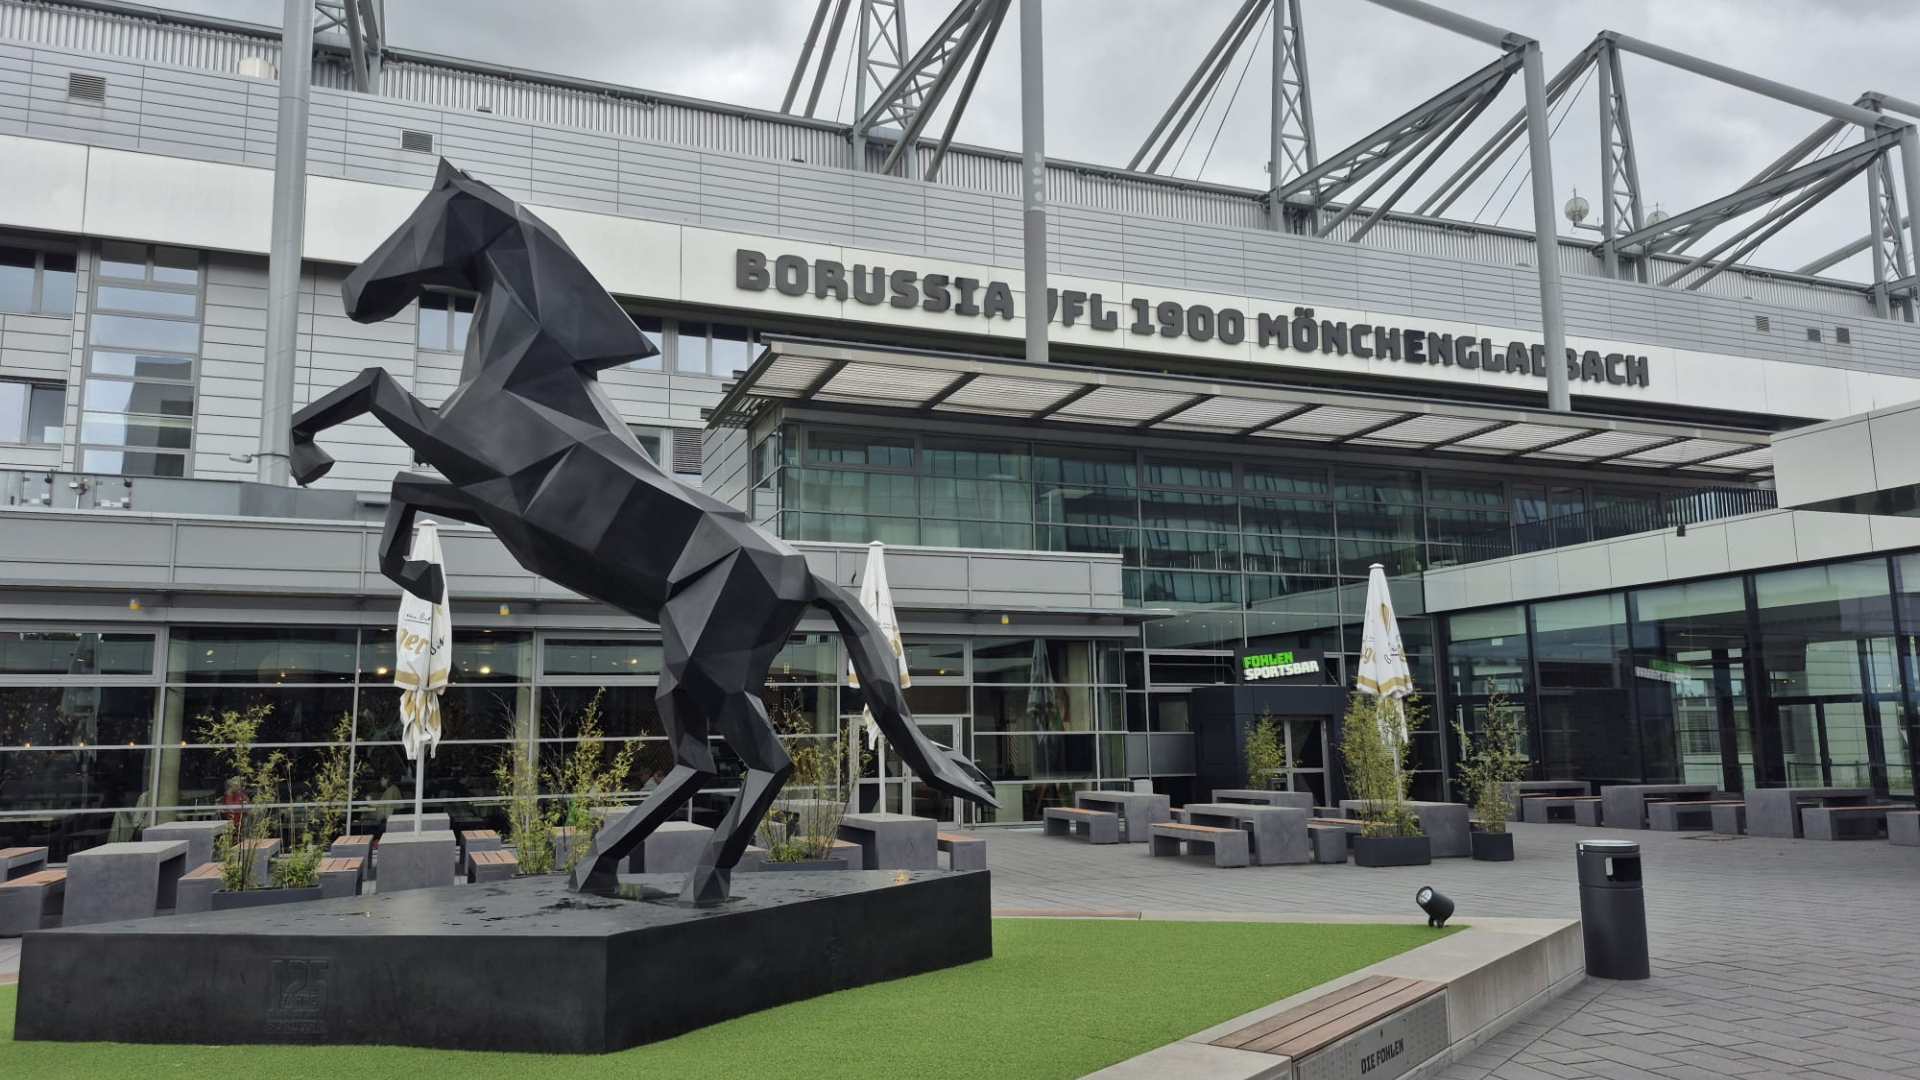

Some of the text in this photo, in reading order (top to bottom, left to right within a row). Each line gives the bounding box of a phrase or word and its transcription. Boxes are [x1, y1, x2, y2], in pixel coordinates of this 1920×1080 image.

[735, 248, 1015, 321] BORUSSIA
[1130, 297, 1245, 345] 1900
[1257, 306, 1650, 387] MÖNCHENGLADBACH
[1243, 651, 1293, 669] FOHLEN
[1243, 660, 1320, 681] SPORTSBAR
[1360, 1037, 1405, 1075] DIE FOHLEN
